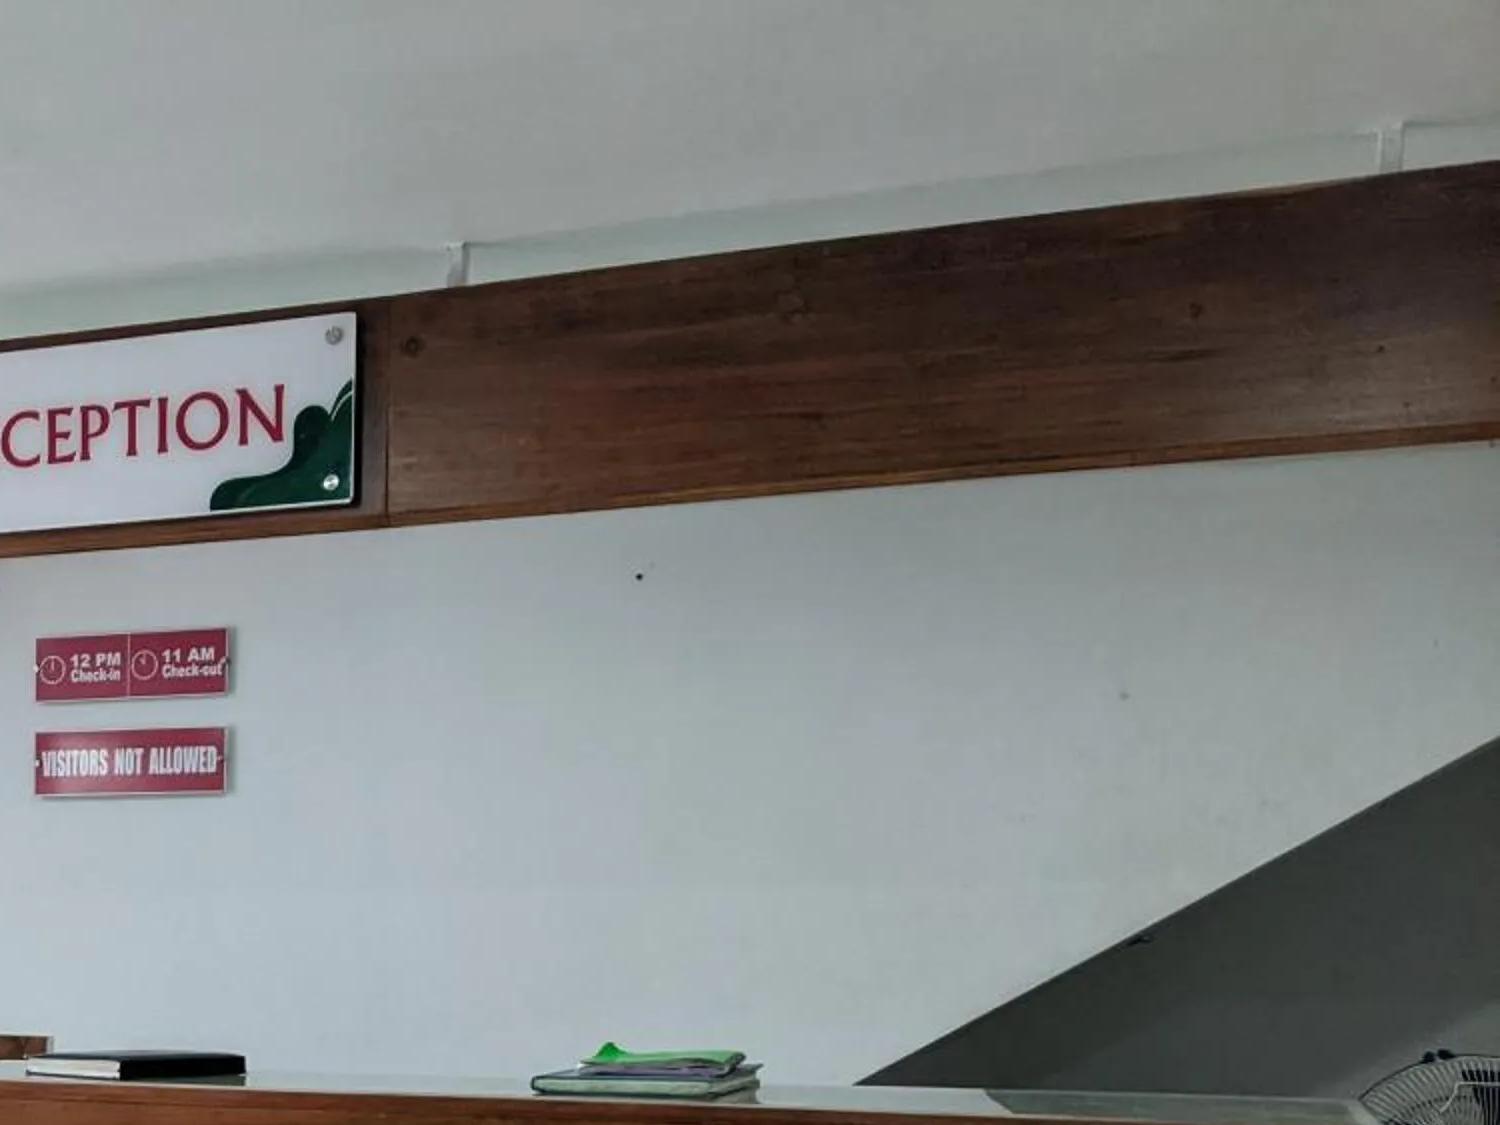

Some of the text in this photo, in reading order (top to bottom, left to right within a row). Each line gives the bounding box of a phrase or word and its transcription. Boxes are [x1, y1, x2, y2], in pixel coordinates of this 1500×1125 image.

[70, 652, 121, 667] 12 PM
[162, 647, 215, 662] 11 AM
[71, 669, 121, 682] Check-in
[162, 663, 222, 678] Check-out
[42, 746, 218, 777] VISITORS NOT ALLOWED
